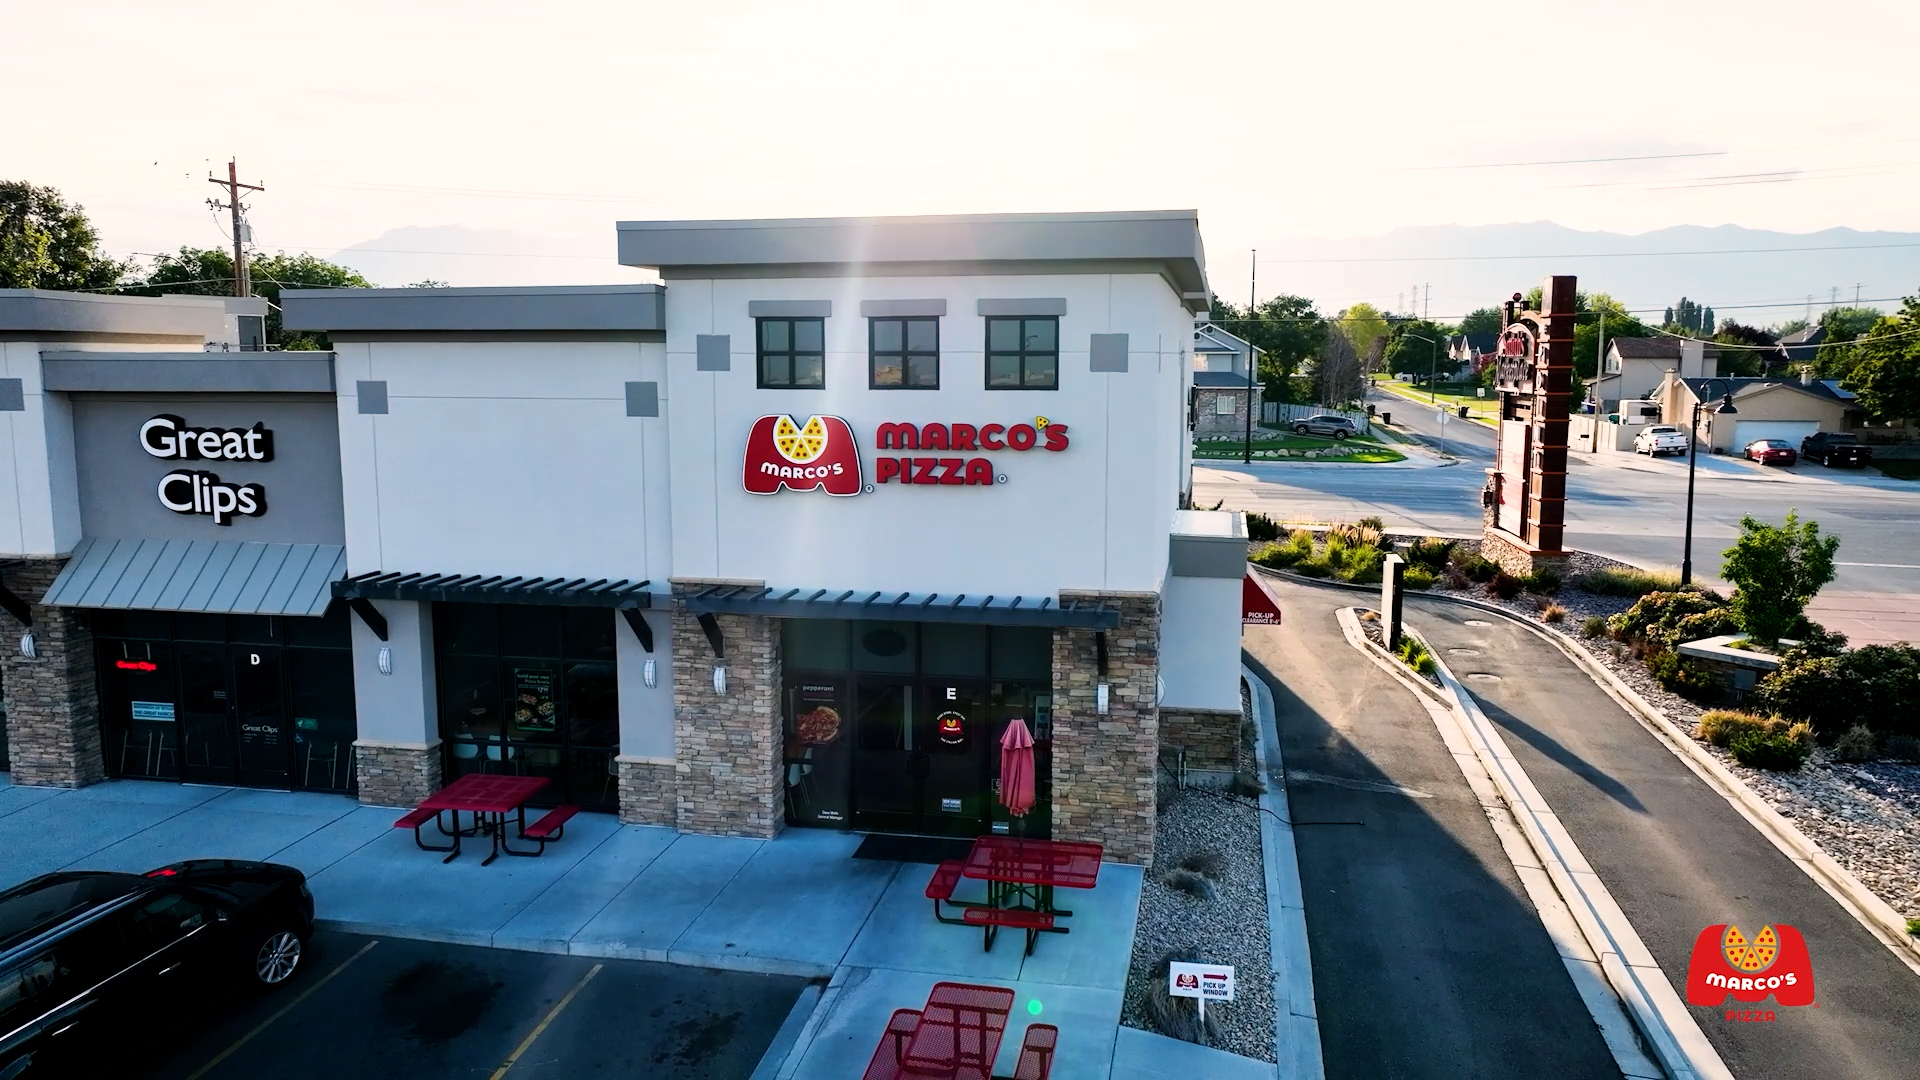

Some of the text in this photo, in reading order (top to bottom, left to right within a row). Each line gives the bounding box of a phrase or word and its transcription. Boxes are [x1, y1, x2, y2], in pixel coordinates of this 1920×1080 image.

[139, 417, 267, 461] Great
[876, 417, 1070, 451] MARCO'S
[760, 462, 844, 480] MARCO'S
[876, 457, 994, 486] PIZZA
[157, 473, 261, 524] Clips
[250, 653, 261, 665] D
[946, 687, 957, 700] E
[242, 724, 278, 734] Great Clips
